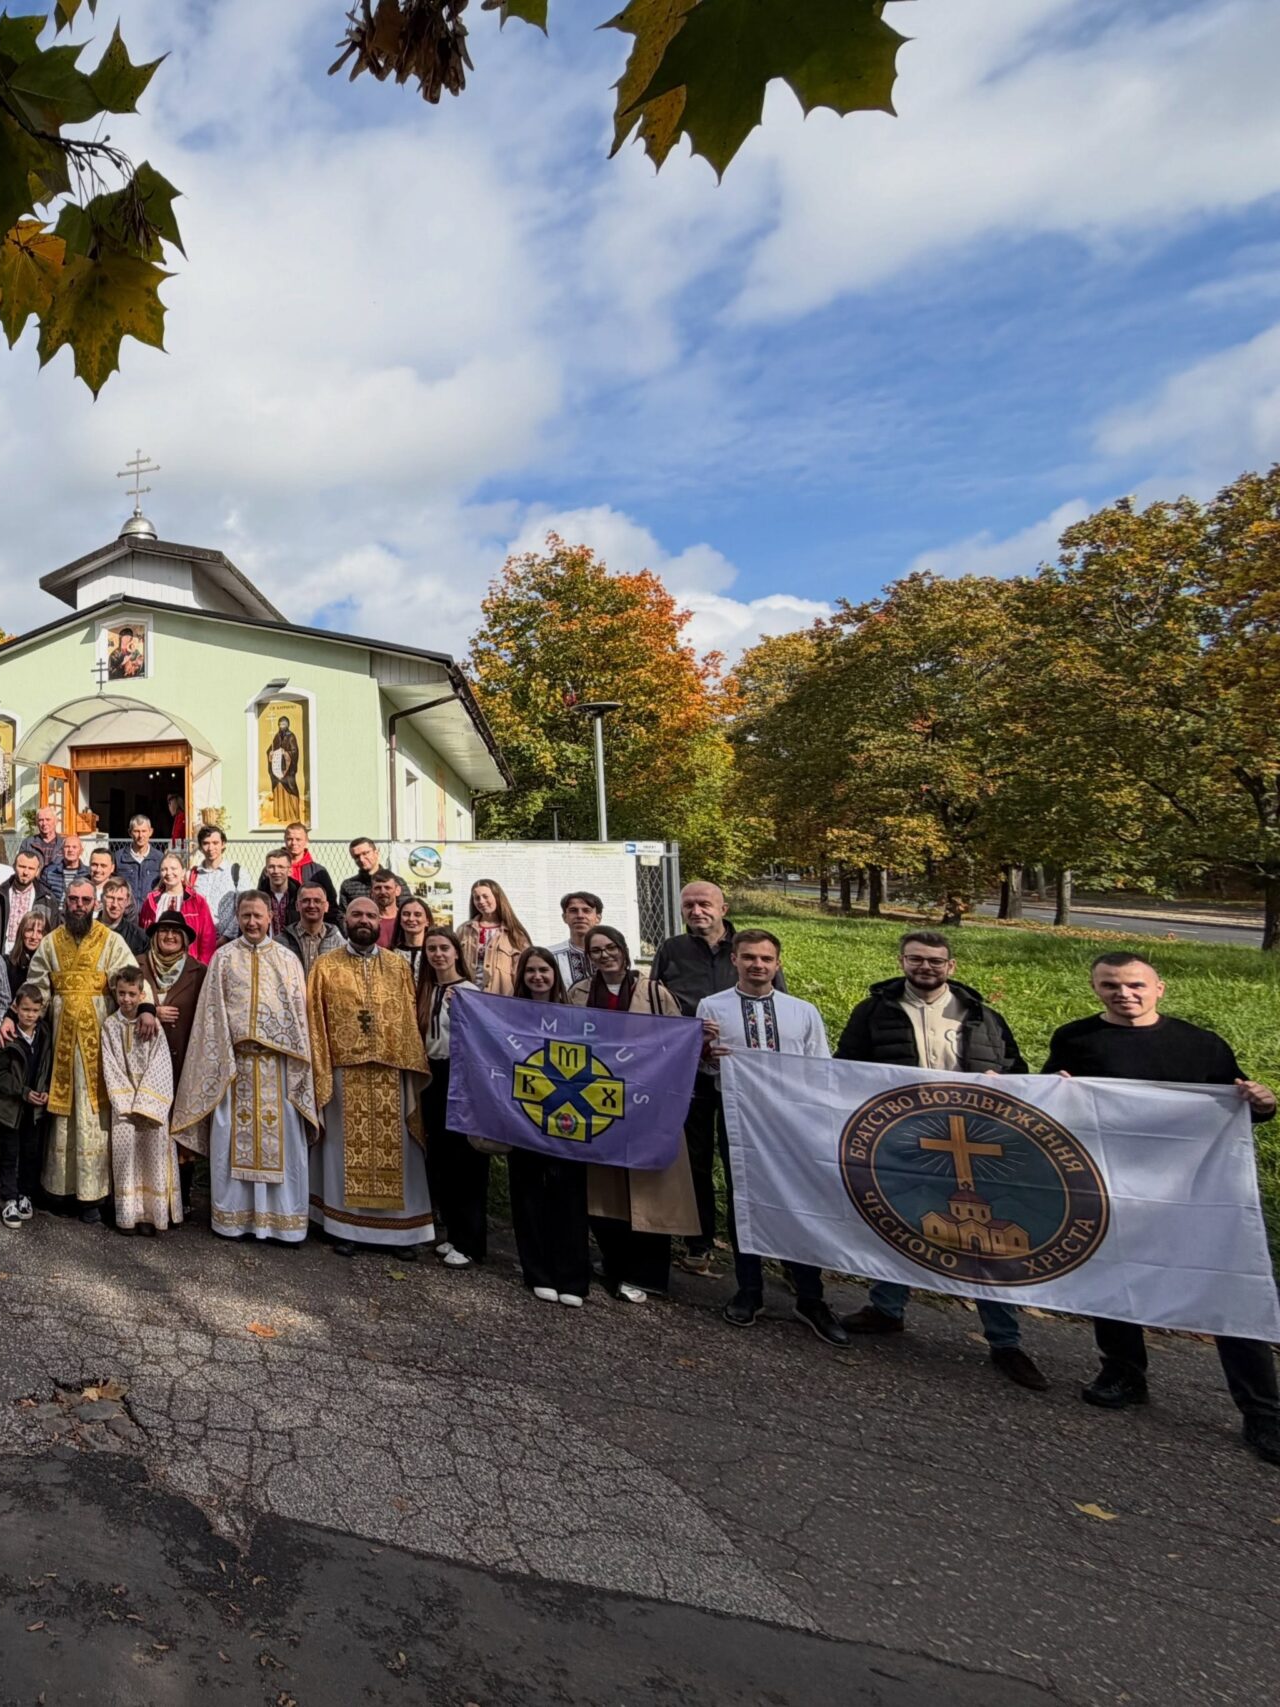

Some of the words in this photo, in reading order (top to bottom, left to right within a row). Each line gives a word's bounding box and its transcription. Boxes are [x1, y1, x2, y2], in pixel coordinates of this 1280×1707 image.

[490, 1017, 650, 1105] TEMPUS
[850, 1095, 914, 1160] БРАТСТВО
[918, 1089, 1085, 1173] ВОЗДВИЖЕННЯ
[864, 1191, 958, 1269] ЧЕСНОГО
[1022, 1217, 1095, 1275] ХРЕСТА
